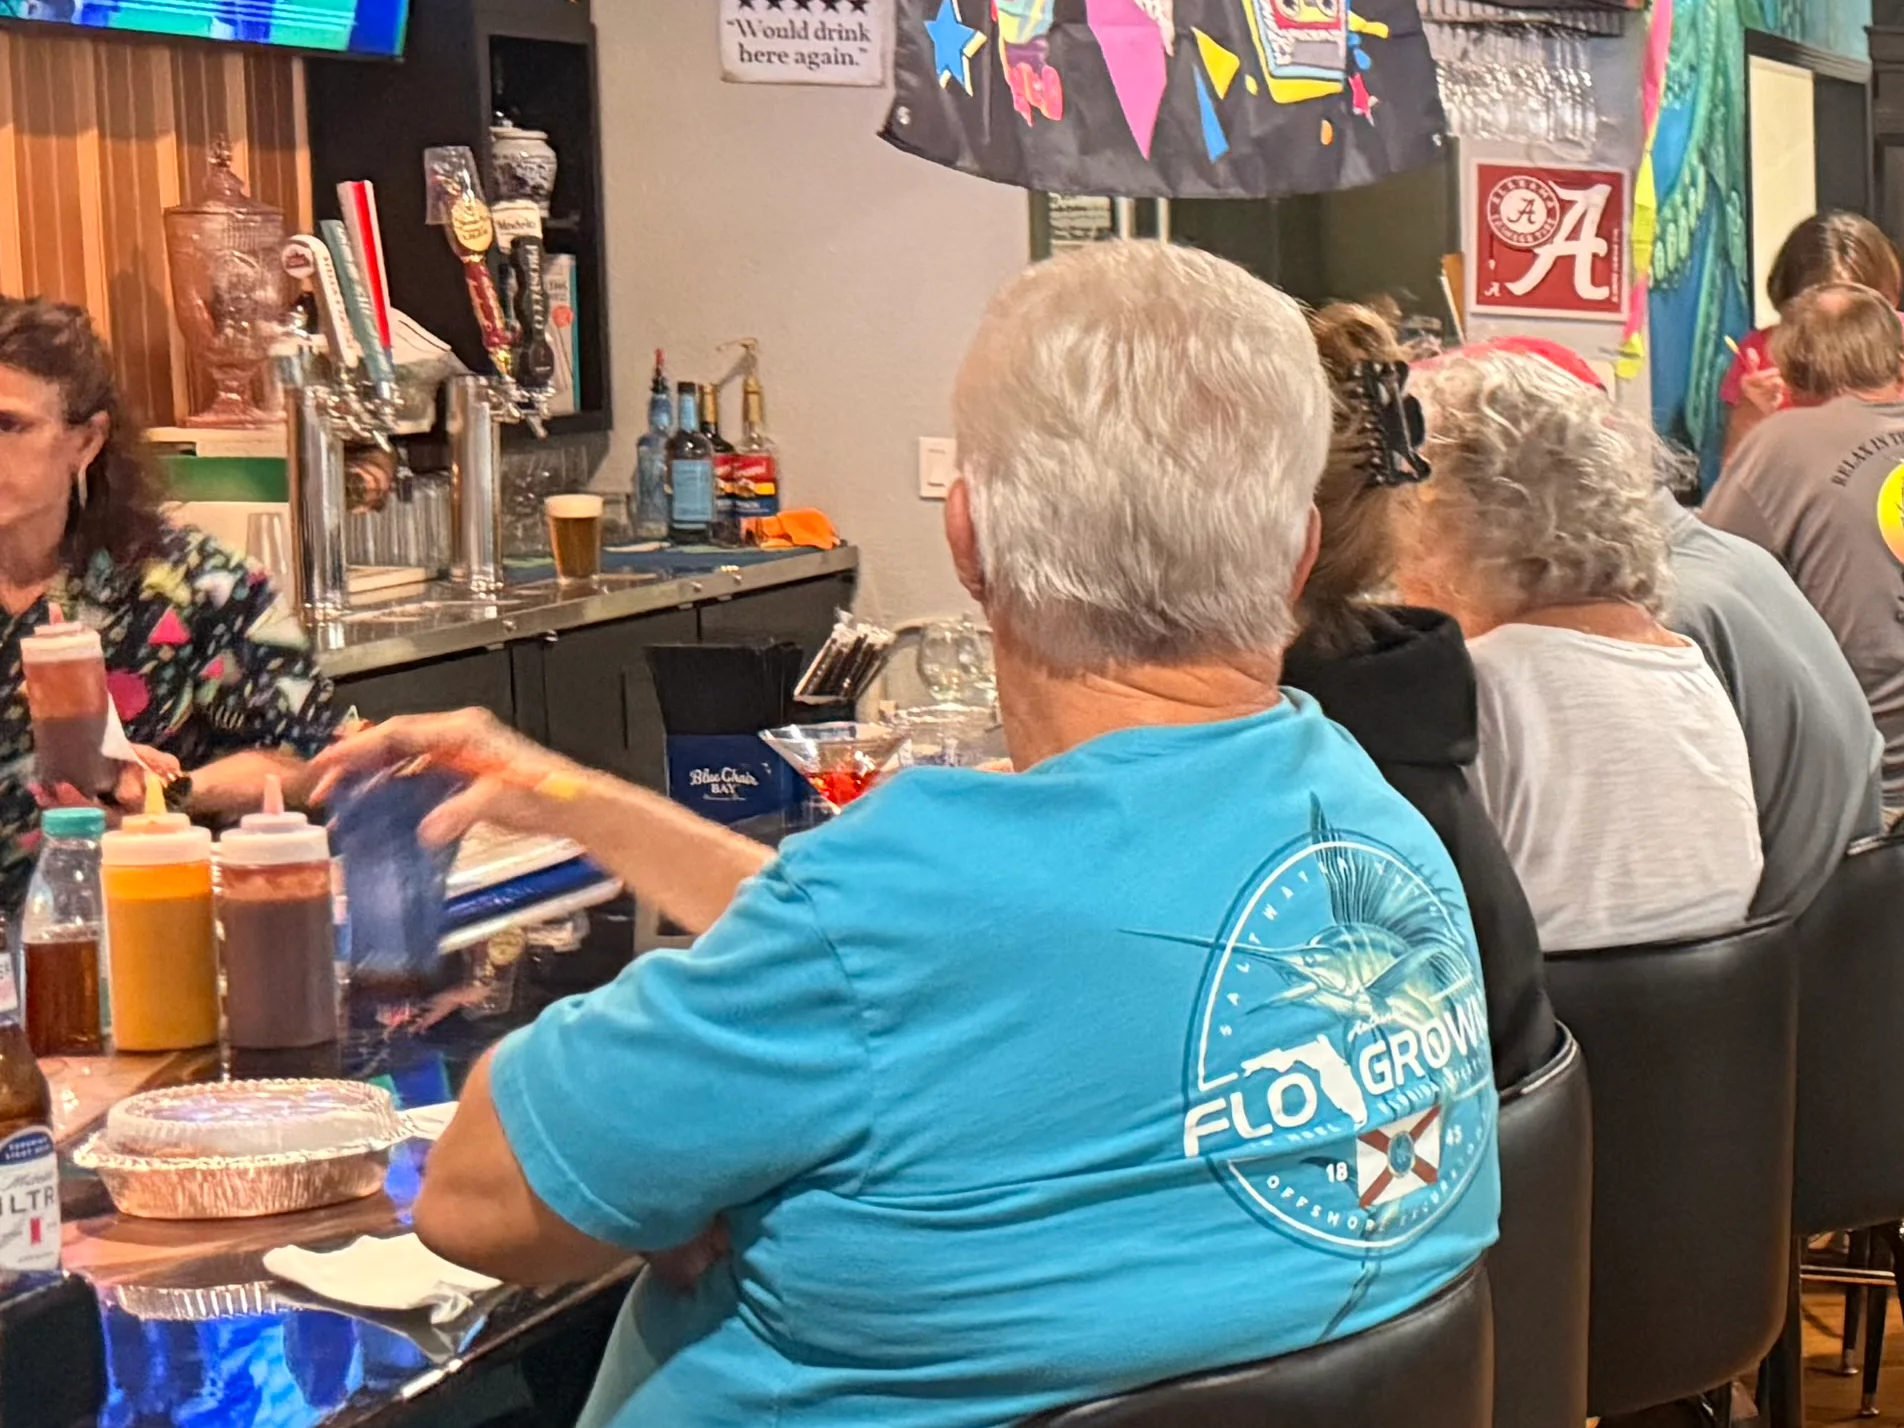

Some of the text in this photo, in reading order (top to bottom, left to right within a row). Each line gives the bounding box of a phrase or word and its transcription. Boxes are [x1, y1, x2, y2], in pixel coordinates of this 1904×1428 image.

[814, 21, 872, 42] drink
[738, 42, 790, 64] here
[1831, 442, 1874, 487] RELAX
[1870, 434, 1889, 451] IN
[689, 768, 721, 786] Blue
[711, 783, 736, 794] BAY
[1184, 1072, 1317, 1158] FLO
[1326, 1161, 1349, 1182] 18
[0, 1185, 54, 1216] LTR
